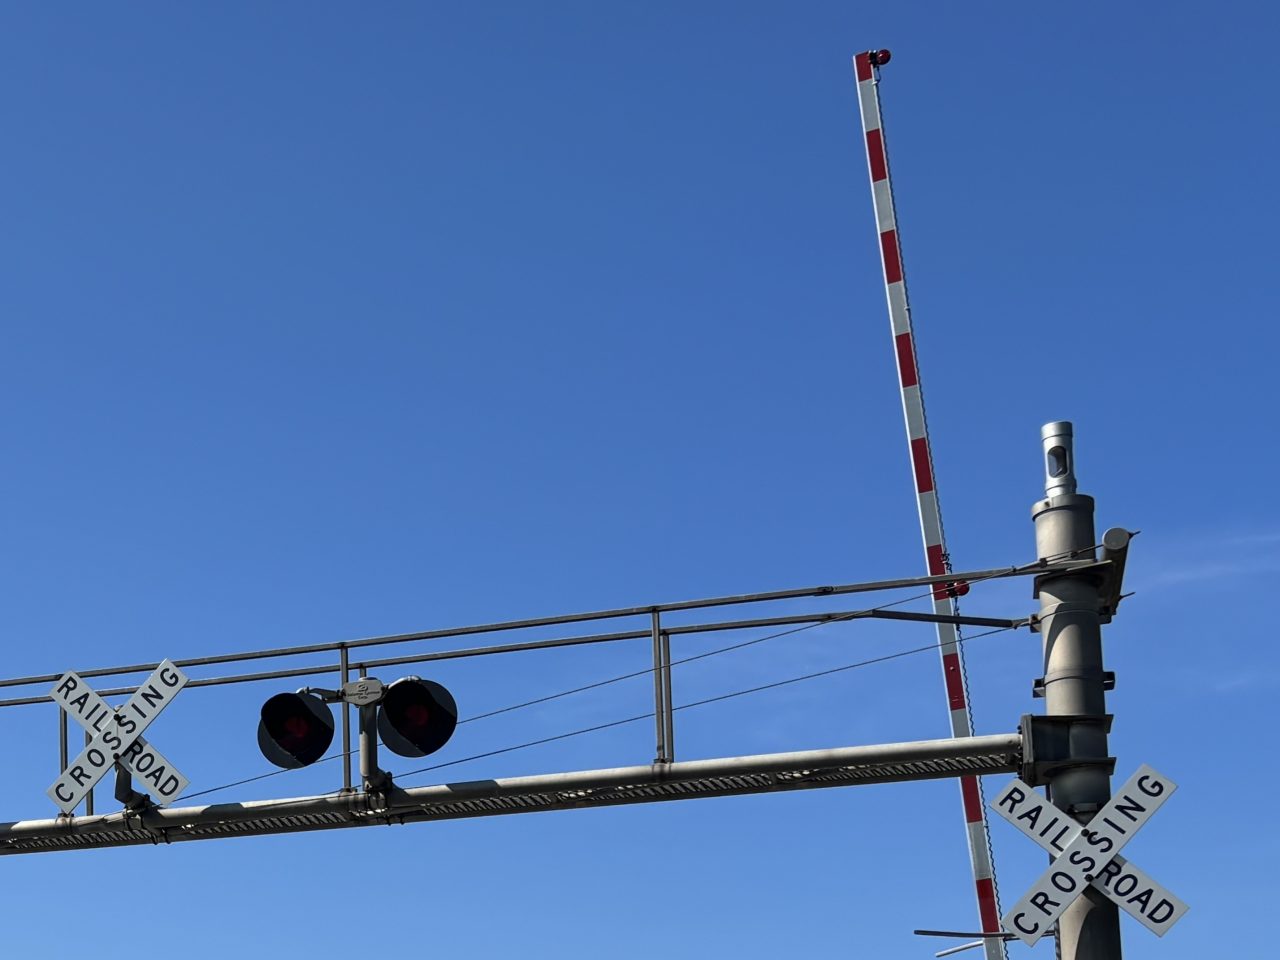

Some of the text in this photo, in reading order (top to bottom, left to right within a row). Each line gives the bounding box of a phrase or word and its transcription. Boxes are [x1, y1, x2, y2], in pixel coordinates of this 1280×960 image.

[55, 668, 179, 803] CROSSING
[57, 676, 179, 796] RAIL ROAD
[999, 787, 1174, 924] RAIL ROAD
[1013, 775, 1163, 935] CROSSING
